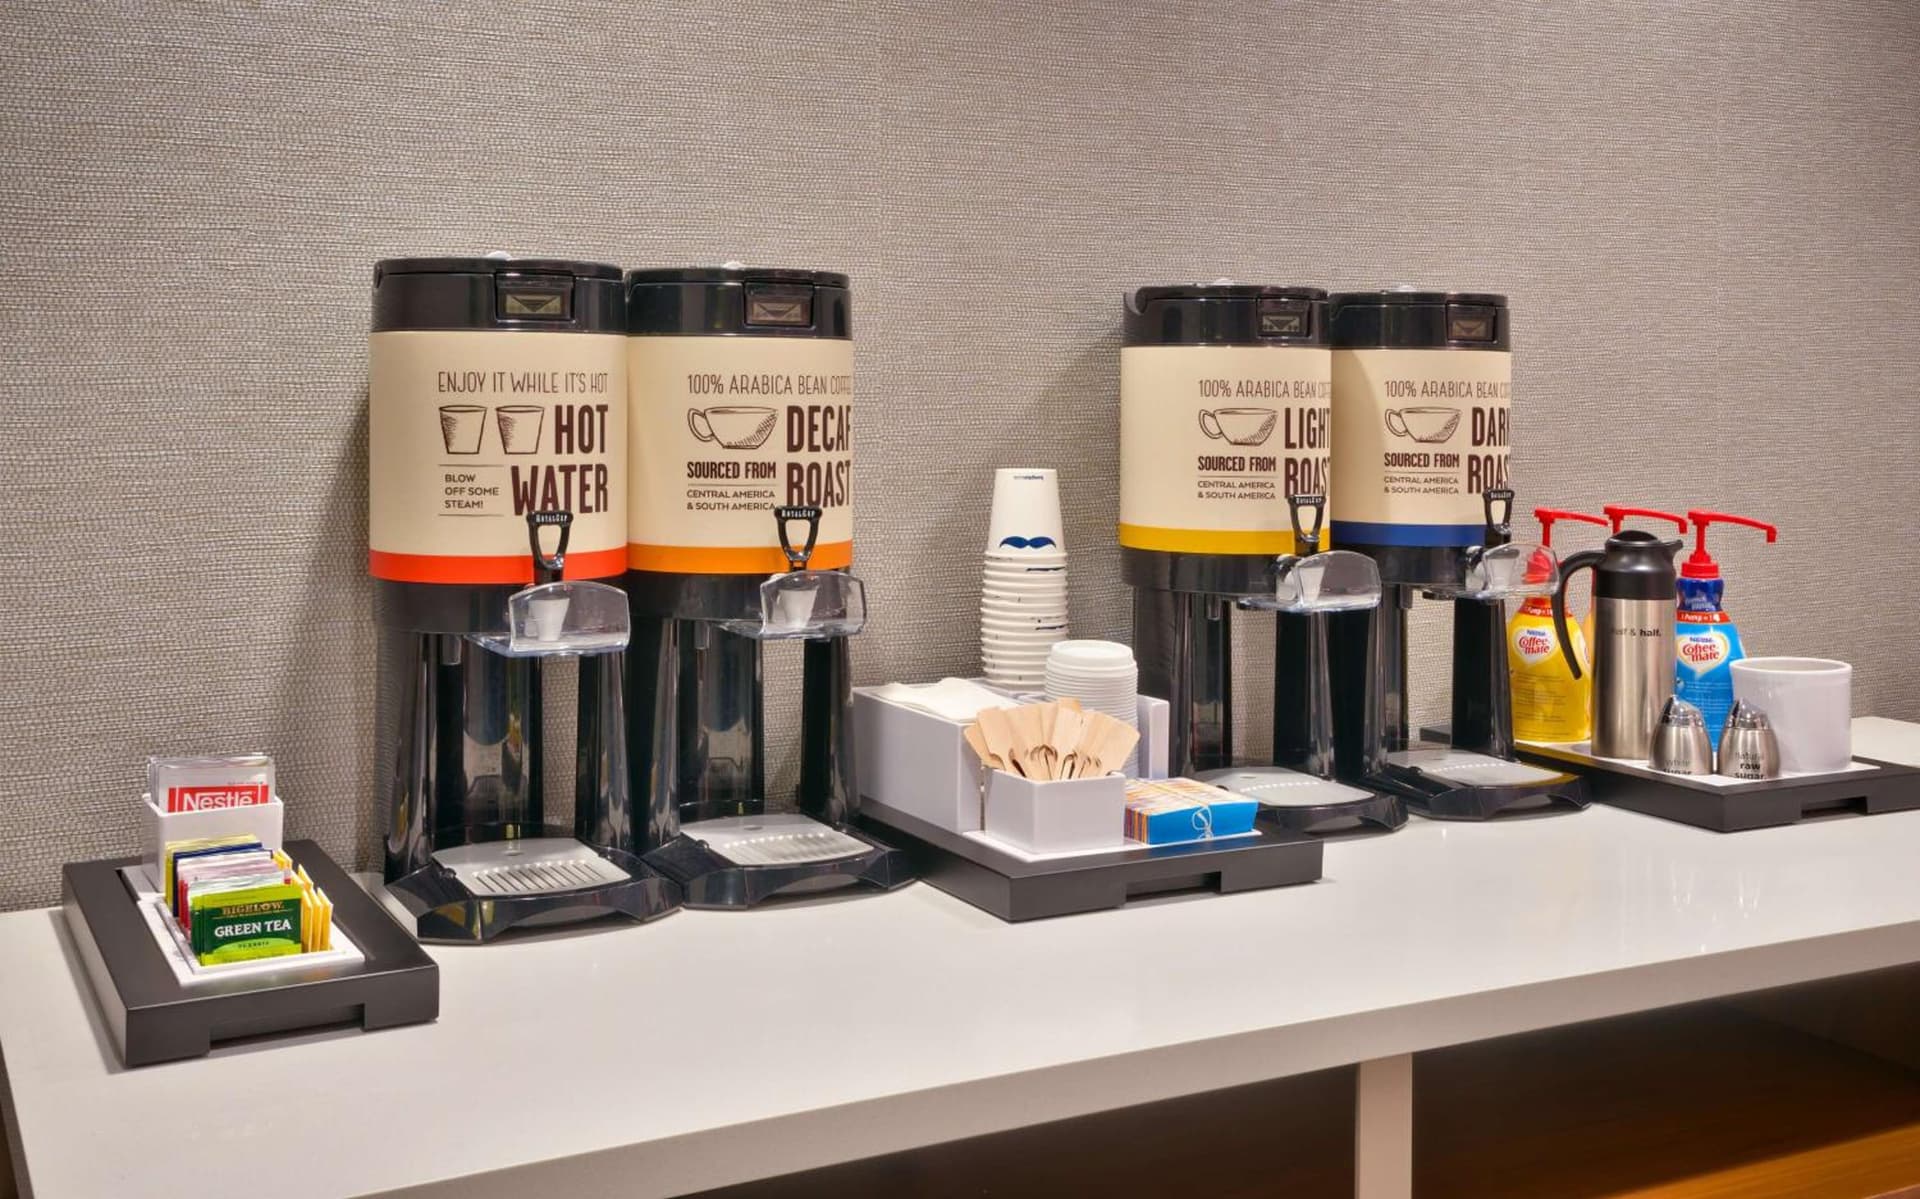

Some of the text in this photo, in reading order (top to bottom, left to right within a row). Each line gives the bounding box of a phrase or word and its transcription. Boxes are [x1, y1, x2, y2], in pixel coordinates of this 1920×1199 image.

[438, 371, 608, 393] ENJOY IT WHILE IT'S HOT
[687, 374, 723, 394] 100%
[729, 374, 792, 395] ARABICA
[799, 375, 827, 395] BEAN
[1199, 379, 1231, 398] 100%
[1236, 380, 1290, 398] ARABICA
[1294, 380, 1316, 398] BEAN
[1385, 381, 1417, 398] 100%
[1421, 380, 1473, 398] ARABICA
[1476, 381, 1498, 398] BEAN
[555, 404, 608, 454] HOT
[1198, 456, 1277, 472] SOURCED FROM
[1384, 453, 1460, 468] SOURCED FROM
[687, 462, 777, 479] SOURCED FROM
[445, 474, 476, 483] BLOW
[787, 459, 851, 507] ROAST
[1384, 476, 1459, 485] CENTRAL AMERICA
[511, 463, 608, 516] WATER
[1198, 481, 1276, 490] CENTRAL AMERICA
[1391, 487, 1421, 495] SOUTH
[1422, 487, 1459, 495] AMERICA
[445, 487, 499, 496] OFF SOME
[687, 490, 776, 499] CENTRAL AMERICA
[1206, 492, 1236, 500] SOUTH
[1238, 492, 1276, 500] AMERICA
[445, 500, 484, 509] STEAM!
[687, 502, 776, 512] & SOUTH AMERICA
[1525, 646, 1550, 655] mate
[1692, 651, 1719, 662] mate
[1740, 763, 1761, 771] raw
[214, 919, 292, 938] GREEN TEA
